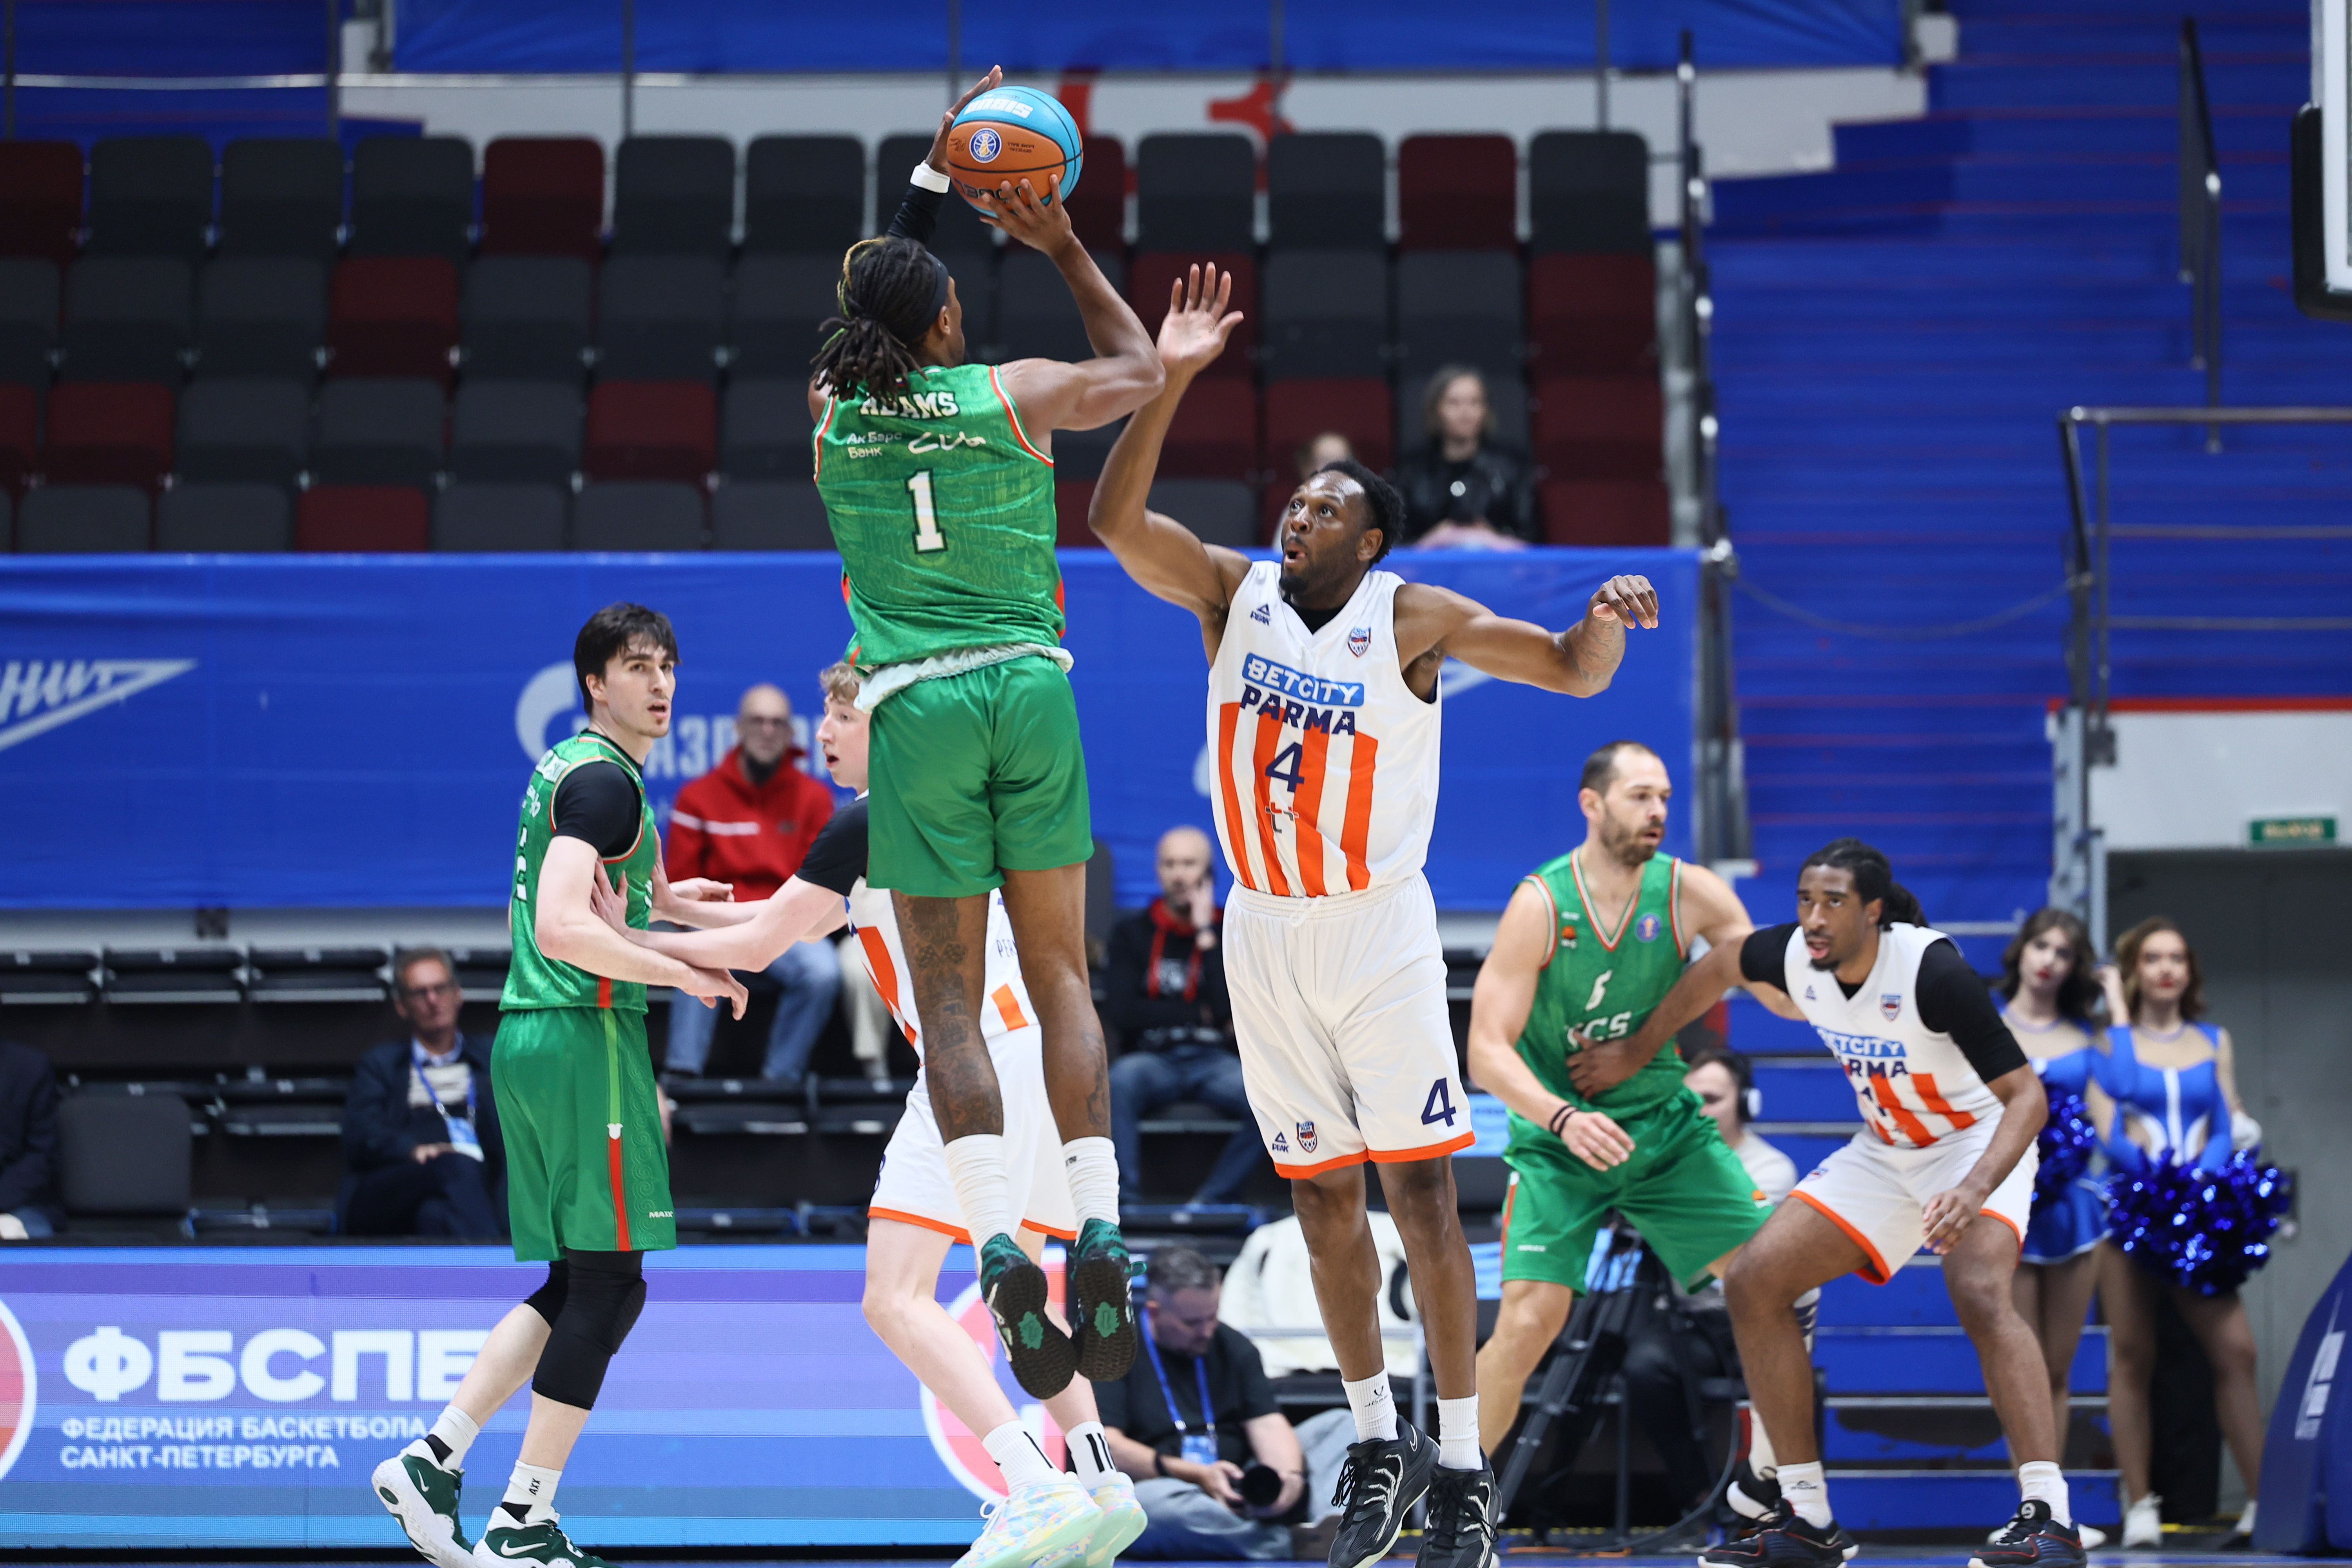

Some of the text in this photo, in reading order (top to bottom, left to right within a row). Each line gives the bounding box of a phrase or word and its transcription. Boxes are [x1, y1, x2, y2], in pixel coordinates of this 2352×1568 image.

[964, 98, 1034, 118] SIBUR
[847, 431, 902, 445] Ак Барс
[848, 446, 882, 459] Банк
[905, 469, 947, 554] 1
[1248, 658, 1359, 704] BETCITY
[1240, 684, 1355, 735] PARMA
[1265, 742, 1305, 792] 4
[1421, 1077, 1456, 1127] 4
[1272, 1143, 1289, 1153] PEAK
[61, 1416, 428, 1442] ФЕДЕРАЦИЯ БАСКЕТБОЛА
[60, 1445, 340, 1468] САНКТ-ПЕТЕРБУРГА
